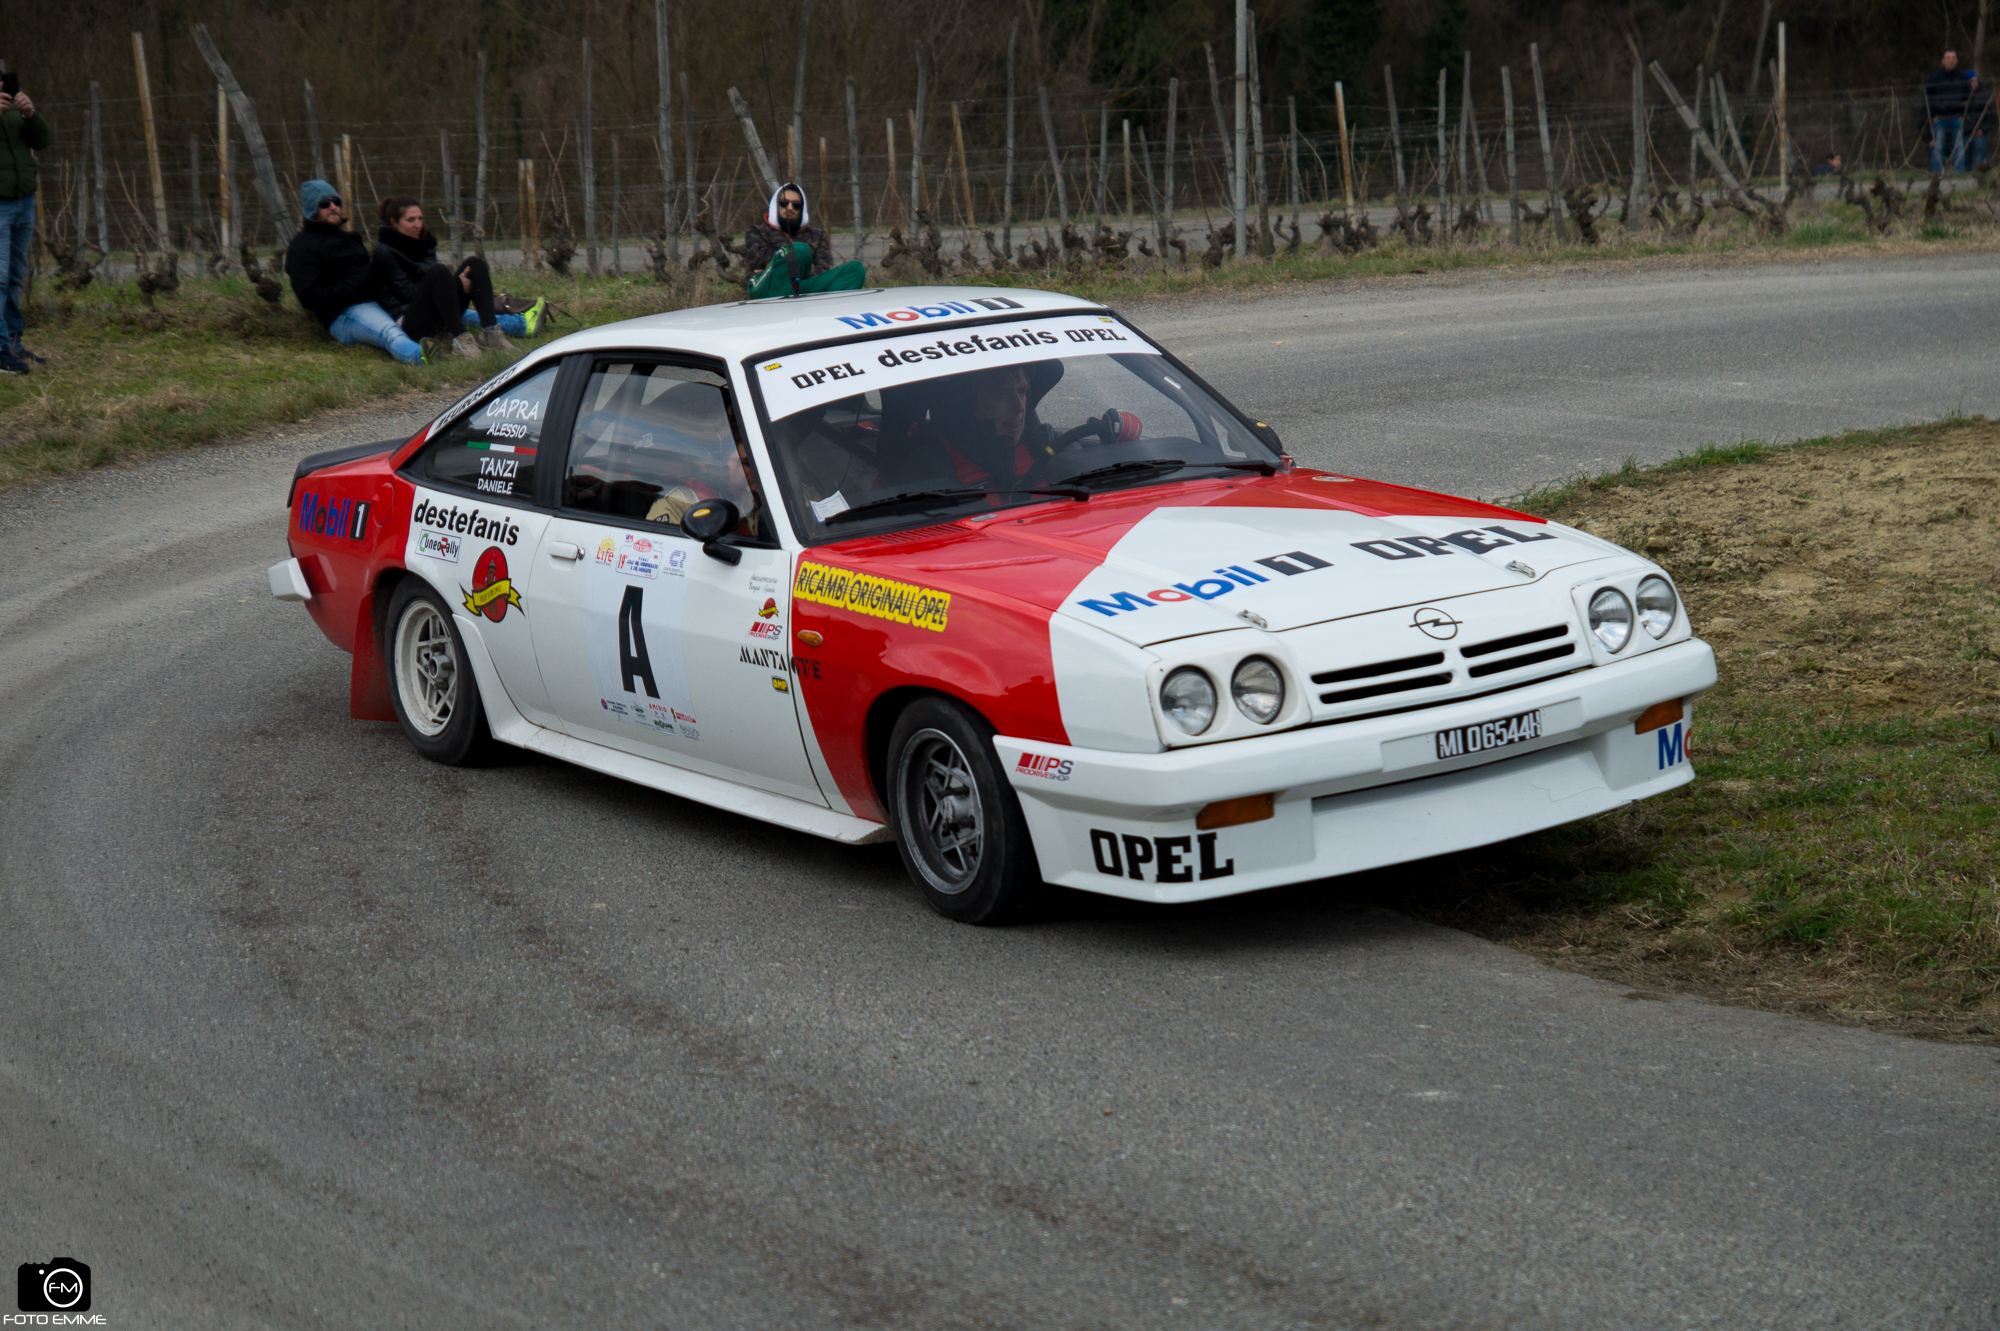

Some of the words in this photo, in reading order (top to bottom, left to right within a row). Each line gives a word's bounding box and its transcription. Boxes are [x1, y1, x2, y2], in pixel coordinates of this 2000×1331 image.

[836, 299, 978, 330] Mobil
[790, 363, 866, 390] OPEL
[877, 328, 1059, 368] destefanis
[1065, 328, 1127, 343] OPEL
[486, 397, 540, 421] CAPRA
[486, 421, 528, 439] ALESSIO
[480, 457, 519, 479] TANZI
[477, 478, 514, 495] DANIELE
[299, 491, 352, 538] Mobil
[352, 501, 369, 540] 1
[413, 498, 520, 546] destefanis
[596, 546, 614, 564] Life
[1349, 525, 1559, 561] OPEL
[796, 567, 851, 602] RICAMBI
[849, 579, 916, 617] ORIGINALI
[915, 594, 949, 626] OPEL
[1076, 565, 1272, 617] Mobil
[618, 584, 661, 700] A
[740, 645, 788, 672] MANTA
[773, 678, 788, 691] OMP
[1439, 729, 1463, 758] MI
[1467, 710, 1541, 752] 06544H
[1014, 766, 1071, 782] PRODRIVESHOP
[1044, 756, 1074, 776] PS
[1089, 828, 1235, 883] OPEL
